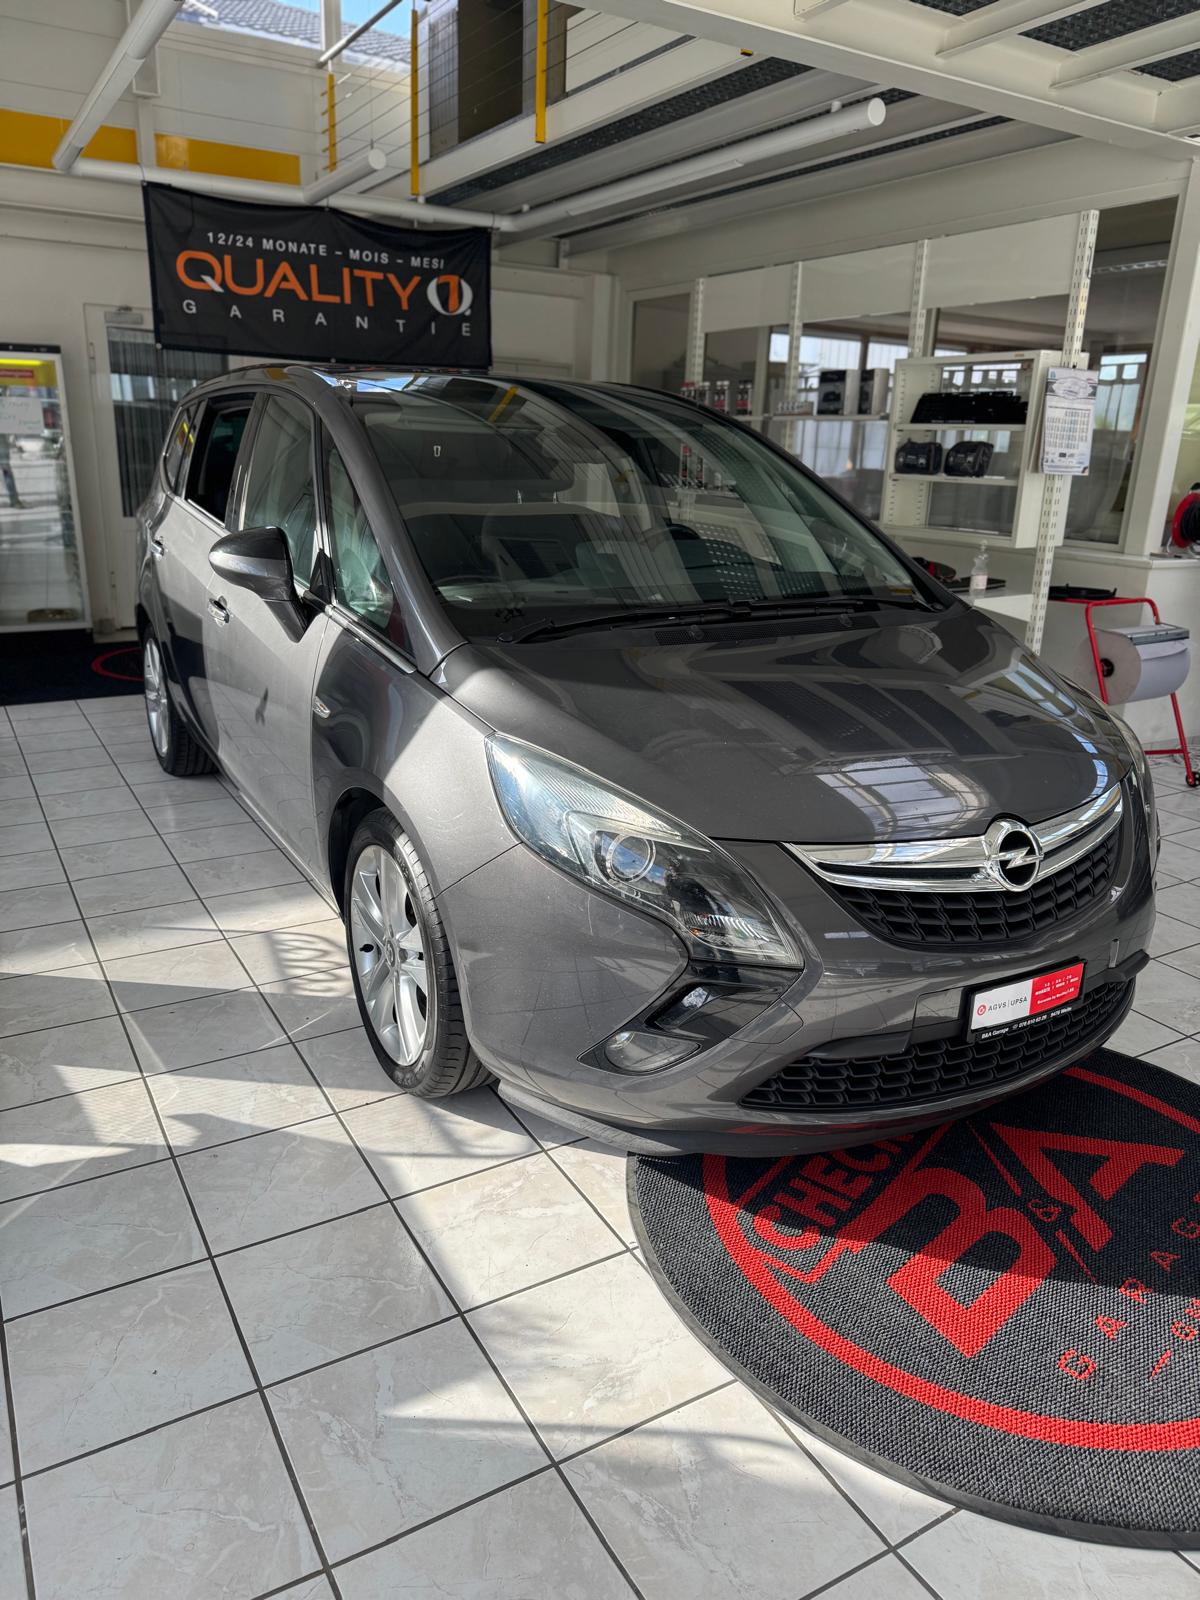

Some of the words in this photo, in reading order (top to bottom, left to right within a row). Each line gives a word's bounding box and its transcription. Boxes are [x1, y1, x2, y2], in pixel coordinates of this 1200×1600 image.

[206, 231, 254, 249] 12/24
[262, 238, 328, 257] MONATE
[349, 248, 390, 265] MOIS
[410, 255, 446, 270] MESI
[175, 249, 422, 311] QUALITY
[182, 299, 472, 337] GARANTIE
[987, 1001, 1007, 1012] AGVS
[1010, 995, 1028, 1007] UPSA
[992, 1027, 1010, 1037] Garage
[1057, 1193, 1200, 1381] GARAG
